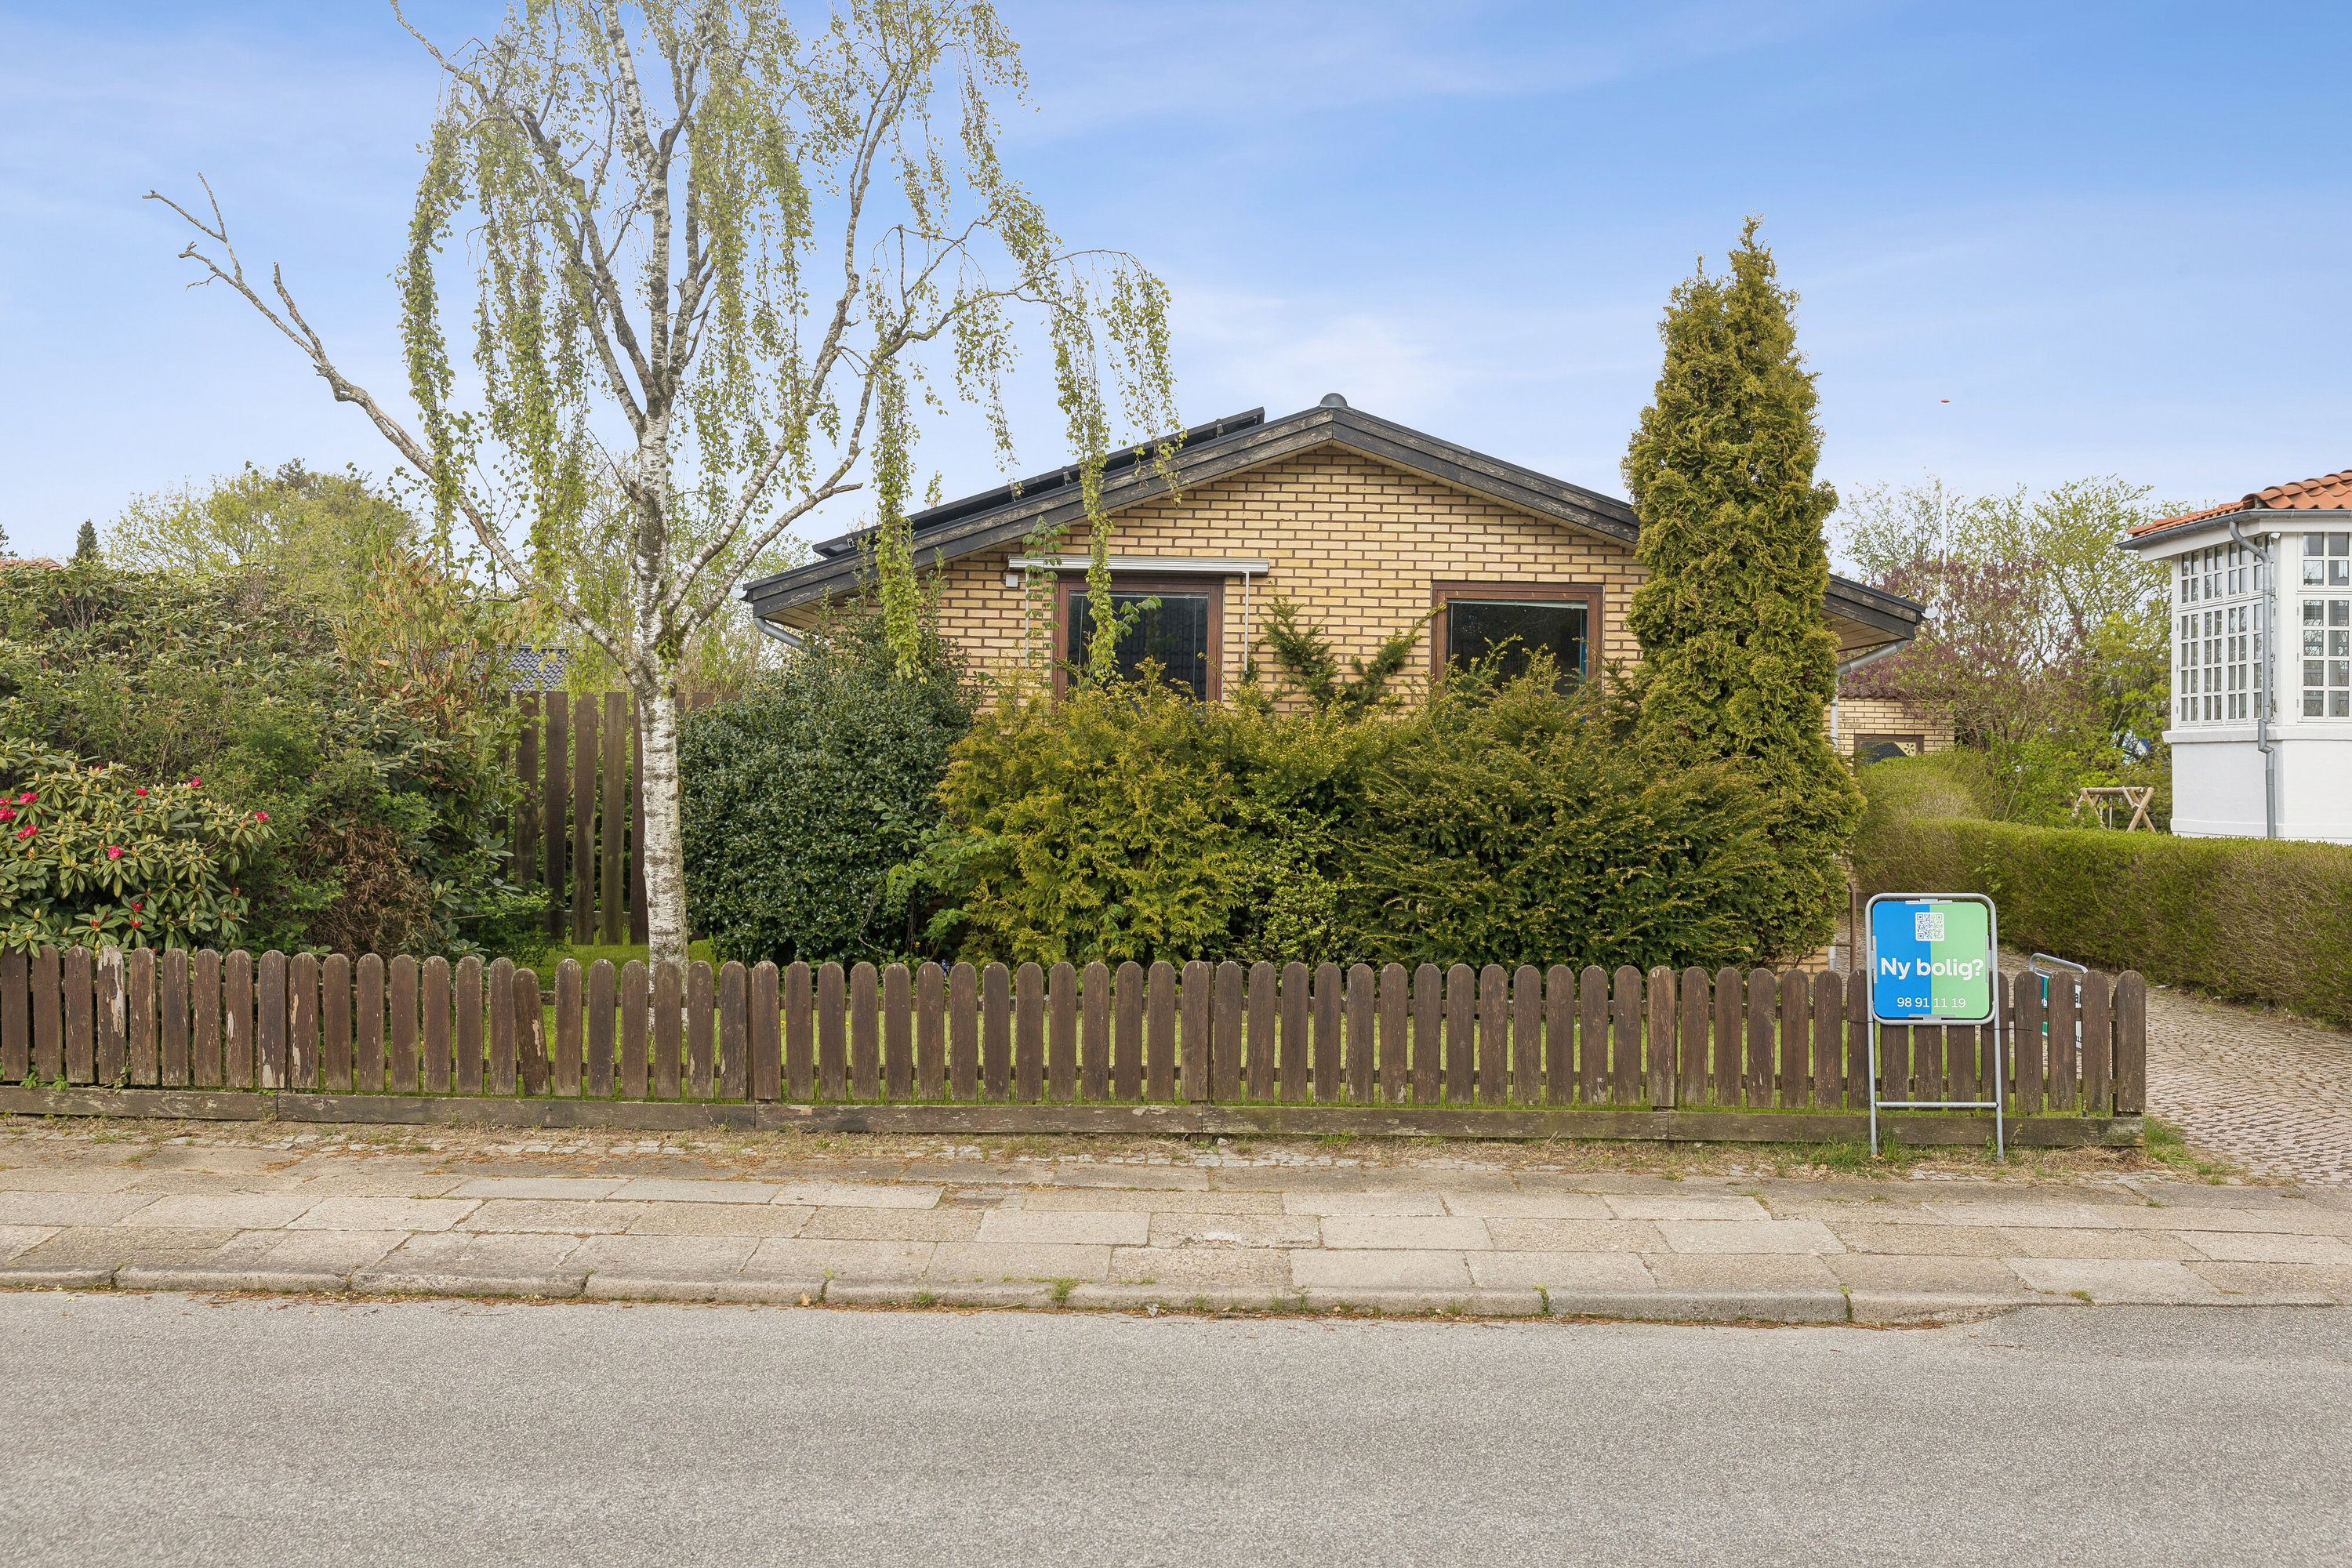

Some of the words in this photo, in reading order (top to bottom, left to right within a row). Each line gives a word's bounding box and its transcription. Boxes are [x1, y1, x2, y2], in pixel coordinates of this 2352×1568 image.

[1881, 957, 1911, 980] Ny
[1916, 958, 1984, 981] bolig?
[1897, 997, 1912, 1007] 98
[1915, 997, 1929, 1007] 91
[1933, 998, 1948, 1007] 11
[1951, 998, 1965, 1008] 19
